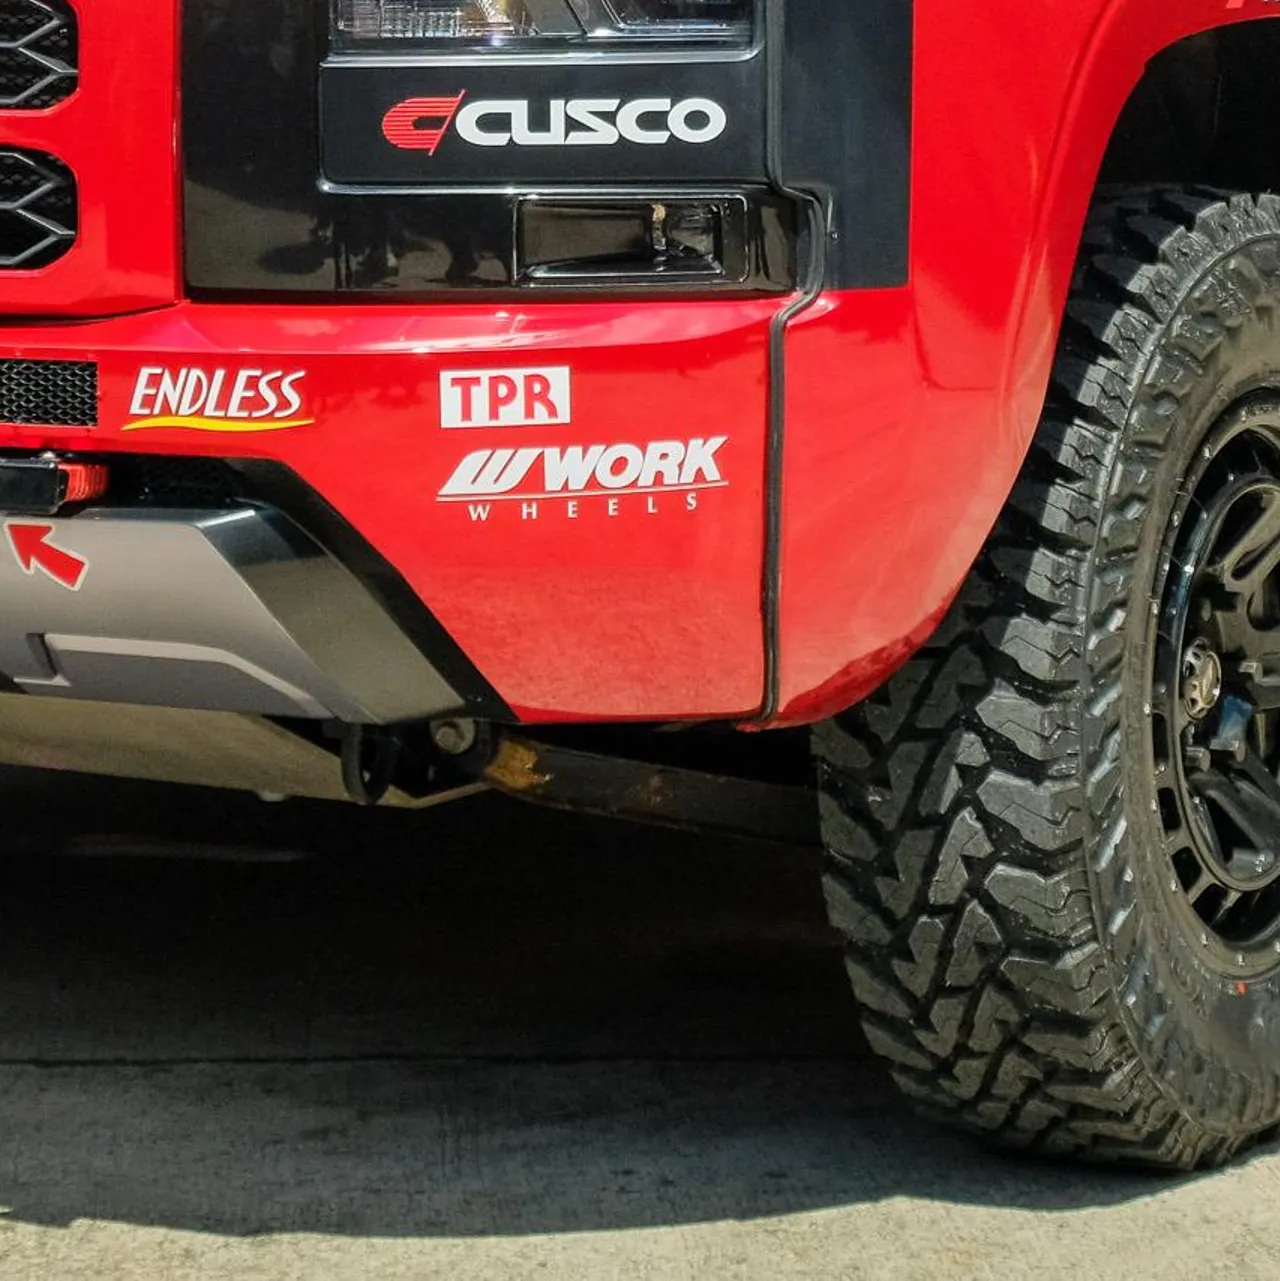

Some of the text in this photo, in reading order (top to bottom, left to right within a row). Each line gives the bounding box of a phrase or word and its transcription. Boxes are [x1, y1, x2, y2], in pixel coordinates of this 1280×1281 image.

[455, 97, 727, 147] CUSCO
[130, 366, 307, 419] ENDLESS
[450, 373, 559, 423] TPR
[544, 436, 729, 492] WORK
[468, 494, 699, 521] WHEELS
